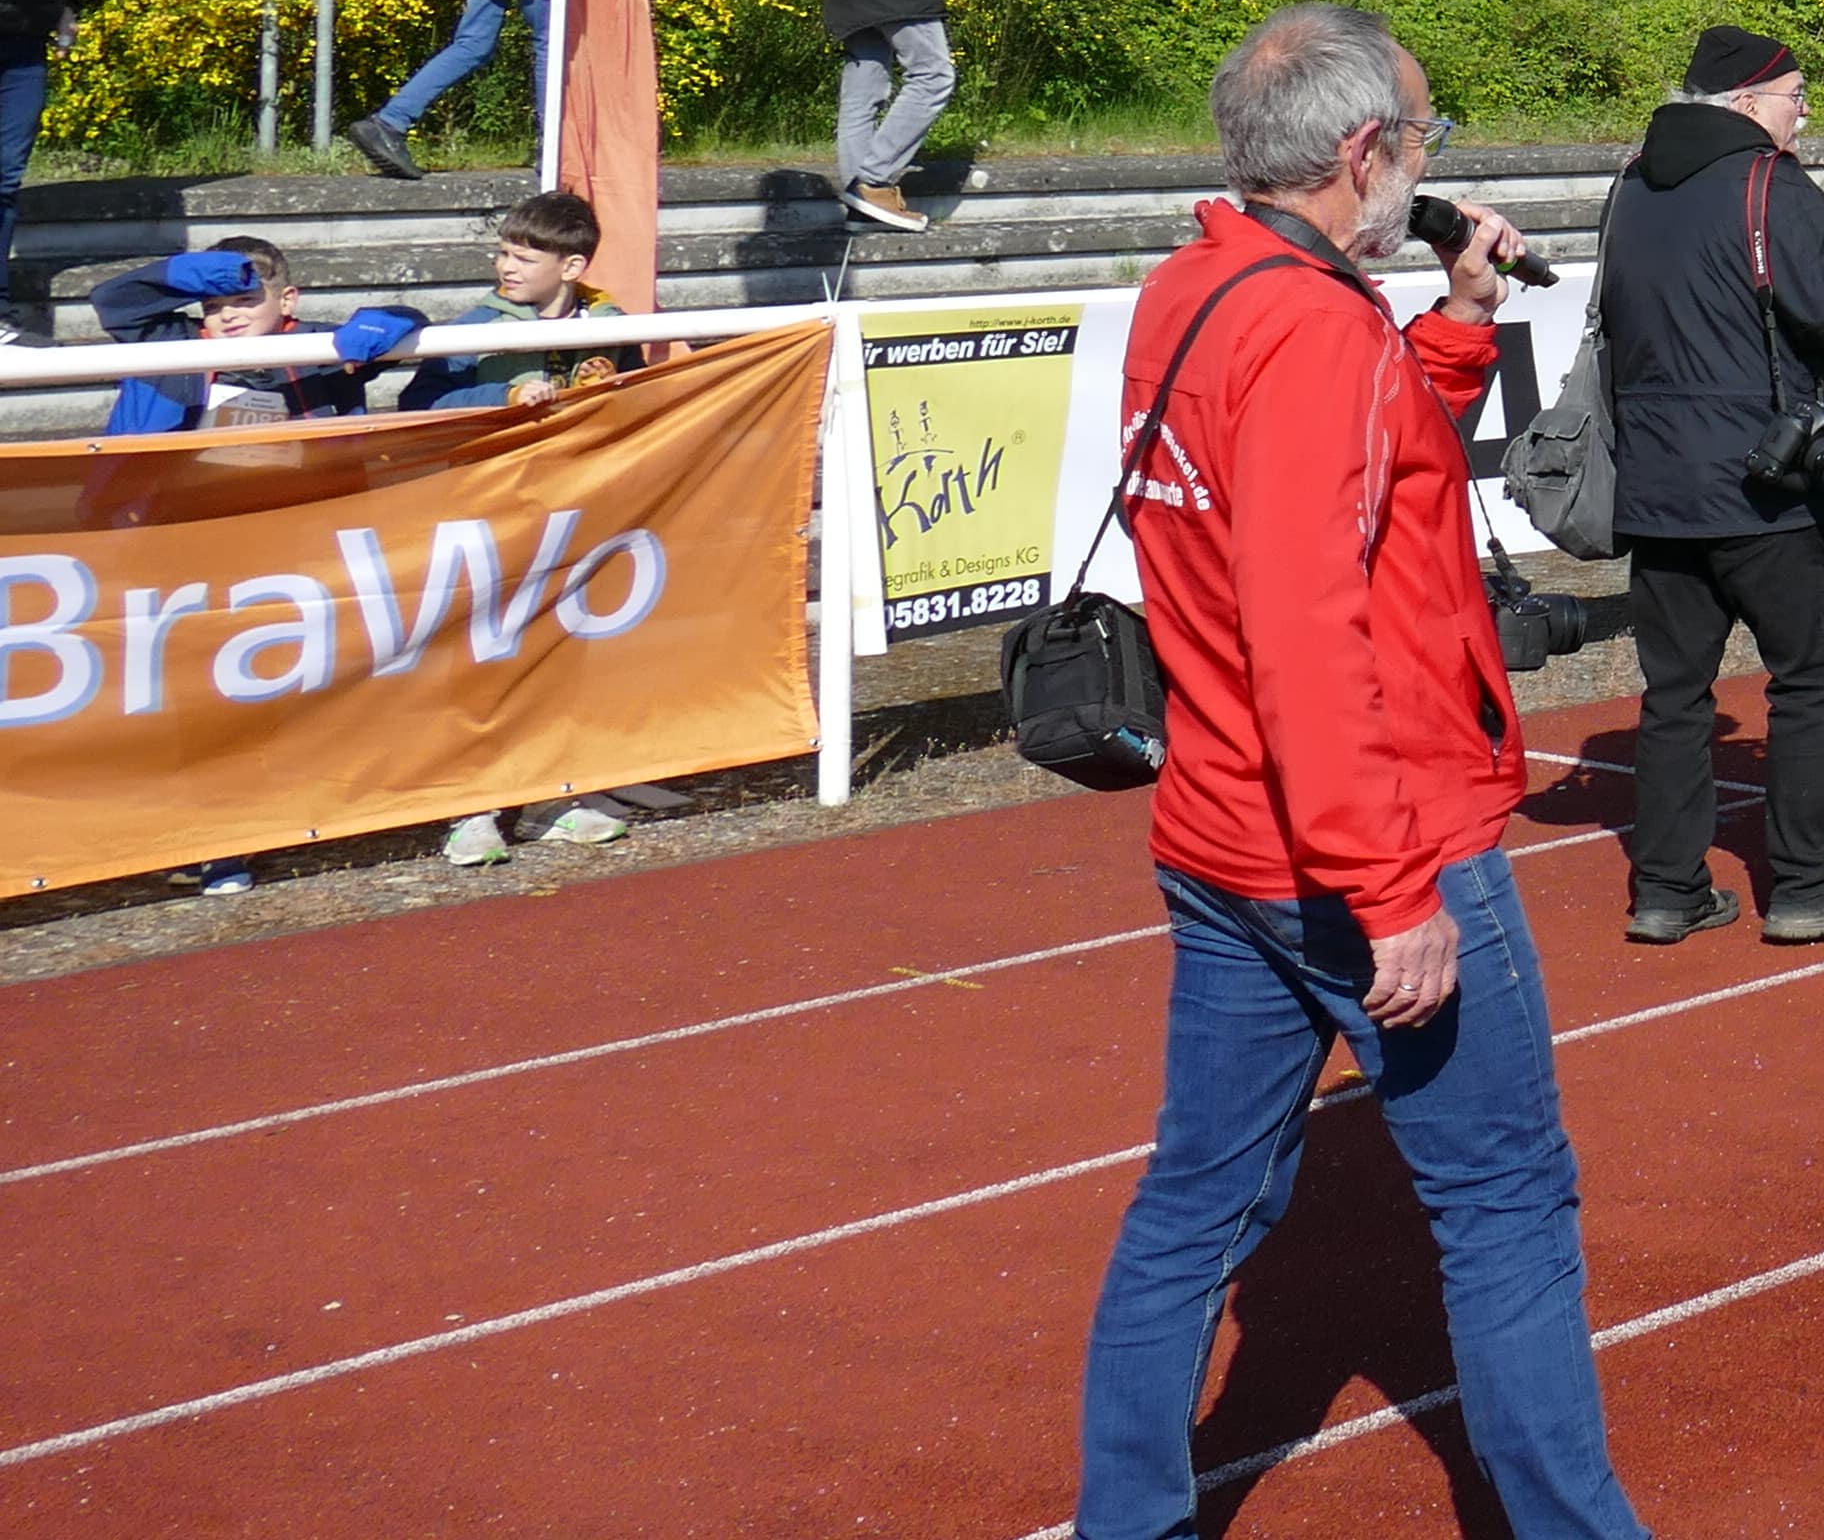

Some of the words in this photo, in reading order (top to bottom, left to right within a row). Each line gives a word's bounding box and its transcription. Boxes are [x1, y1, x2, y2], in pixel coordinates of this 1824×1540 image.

[864, 342, 883, 364] ir
[887, 338, 974, 364] werben
[980, 333, 1018, 357] für
[1020, 329, 1070, 354] Sie!
[885, 563, 935, 591] egrafik
[940, 560, 951, 576] &
[955, 554, 1011, 577] Designs
[1016, 546, 1040, 565] KG
[0, 510, 666, 728] BraWo
